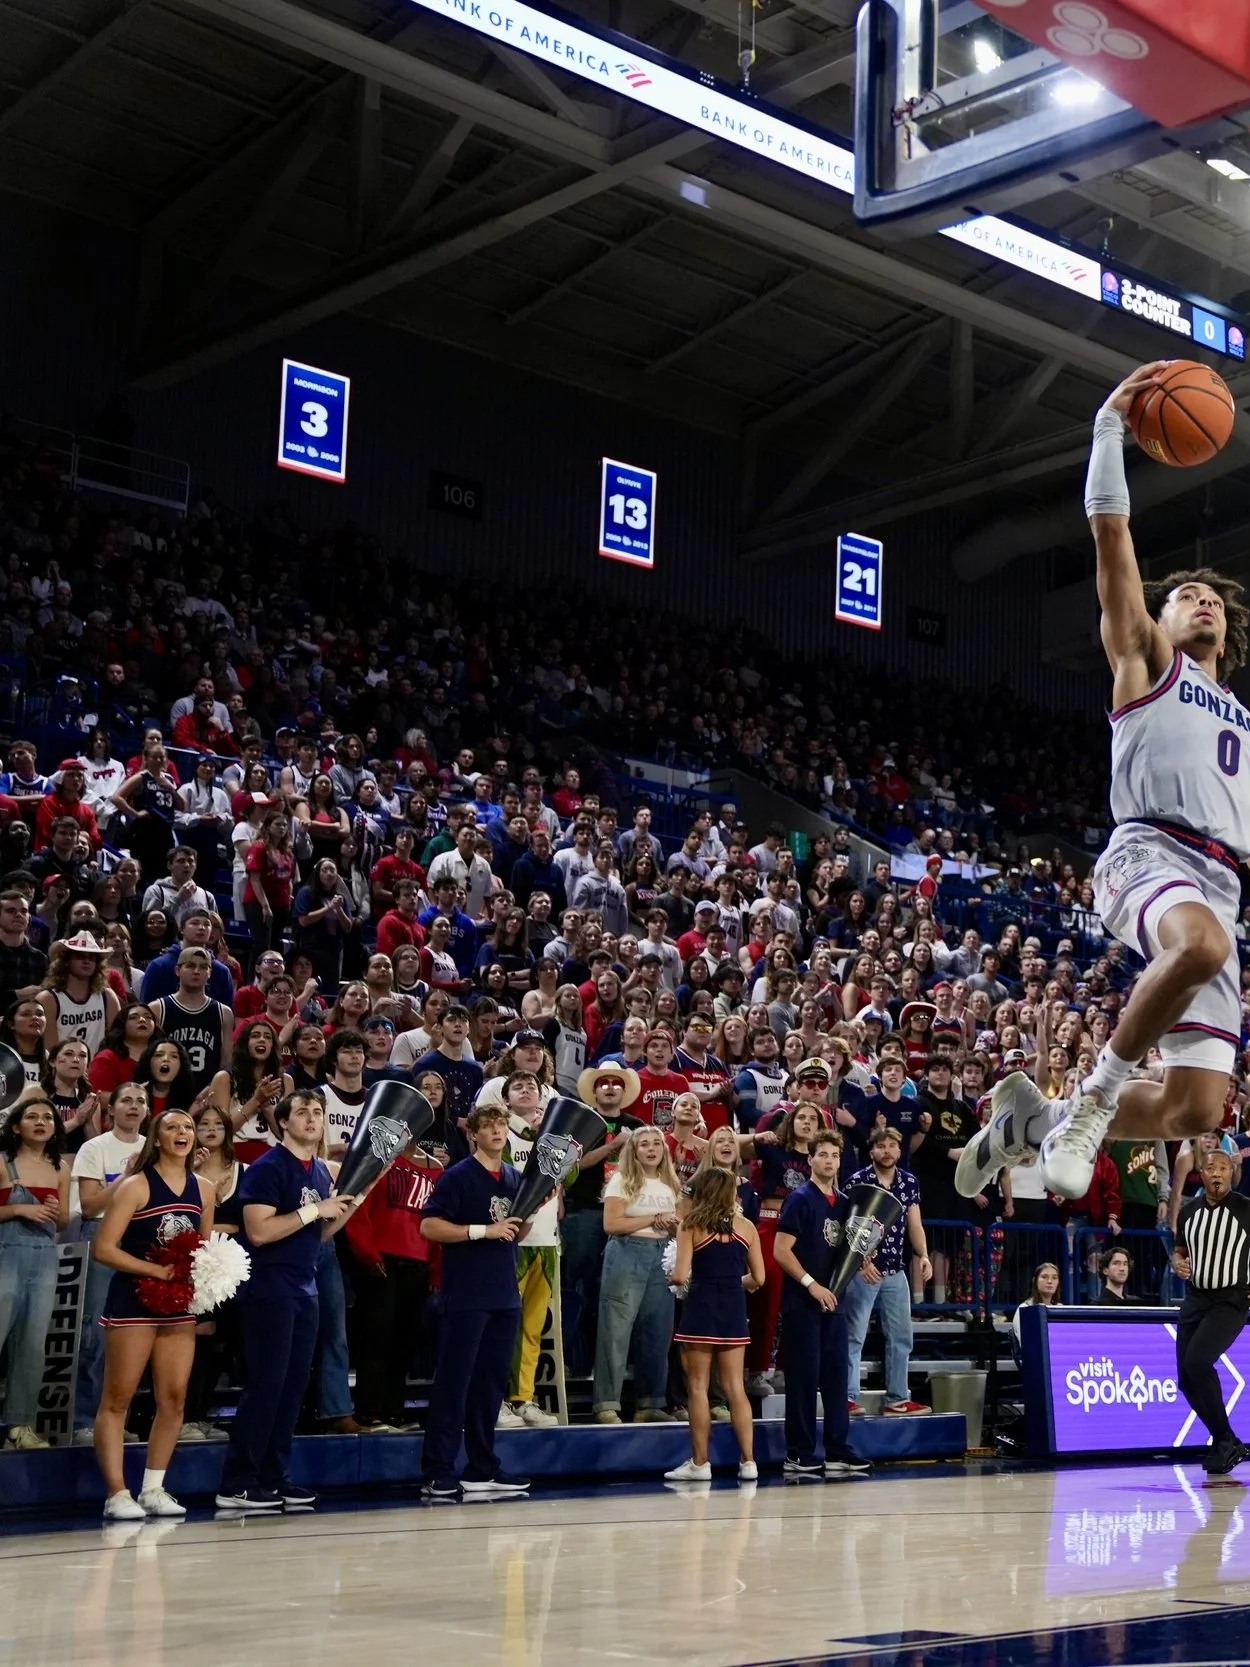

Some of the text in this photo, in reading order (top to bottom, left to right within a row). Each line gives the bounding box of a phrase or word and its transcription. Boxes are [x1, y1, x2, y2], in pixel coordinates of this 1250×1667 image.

[444, 0, 610, 76] NK OF AMERICA
[701, 105, 853, 183] BANK OF AMERICA
[973, 226, 990, 241] OF
[995, 237, 1057, 272] AMERICA
[1121, 279, 1181, 314] 3-POINT
[1121, 294, 1191, 336] COUNTER
[1204, 320, 1215, 340] 0
[293, 377, 338, 397] MORRISON
[300, 401, 328, 437] 3
[443, 484, 476, 509] 106
[609, 493, 648, 530] 13
[843, 561, 876, 596] 21
[917, 617, 941, 637] 107
[1217, 729, 1241, 777] 0
[155, 791, 174, 808] 33
[328, 1113, 358, 1128] GONZ
[1079, 1356, 1114, 1377] visit
